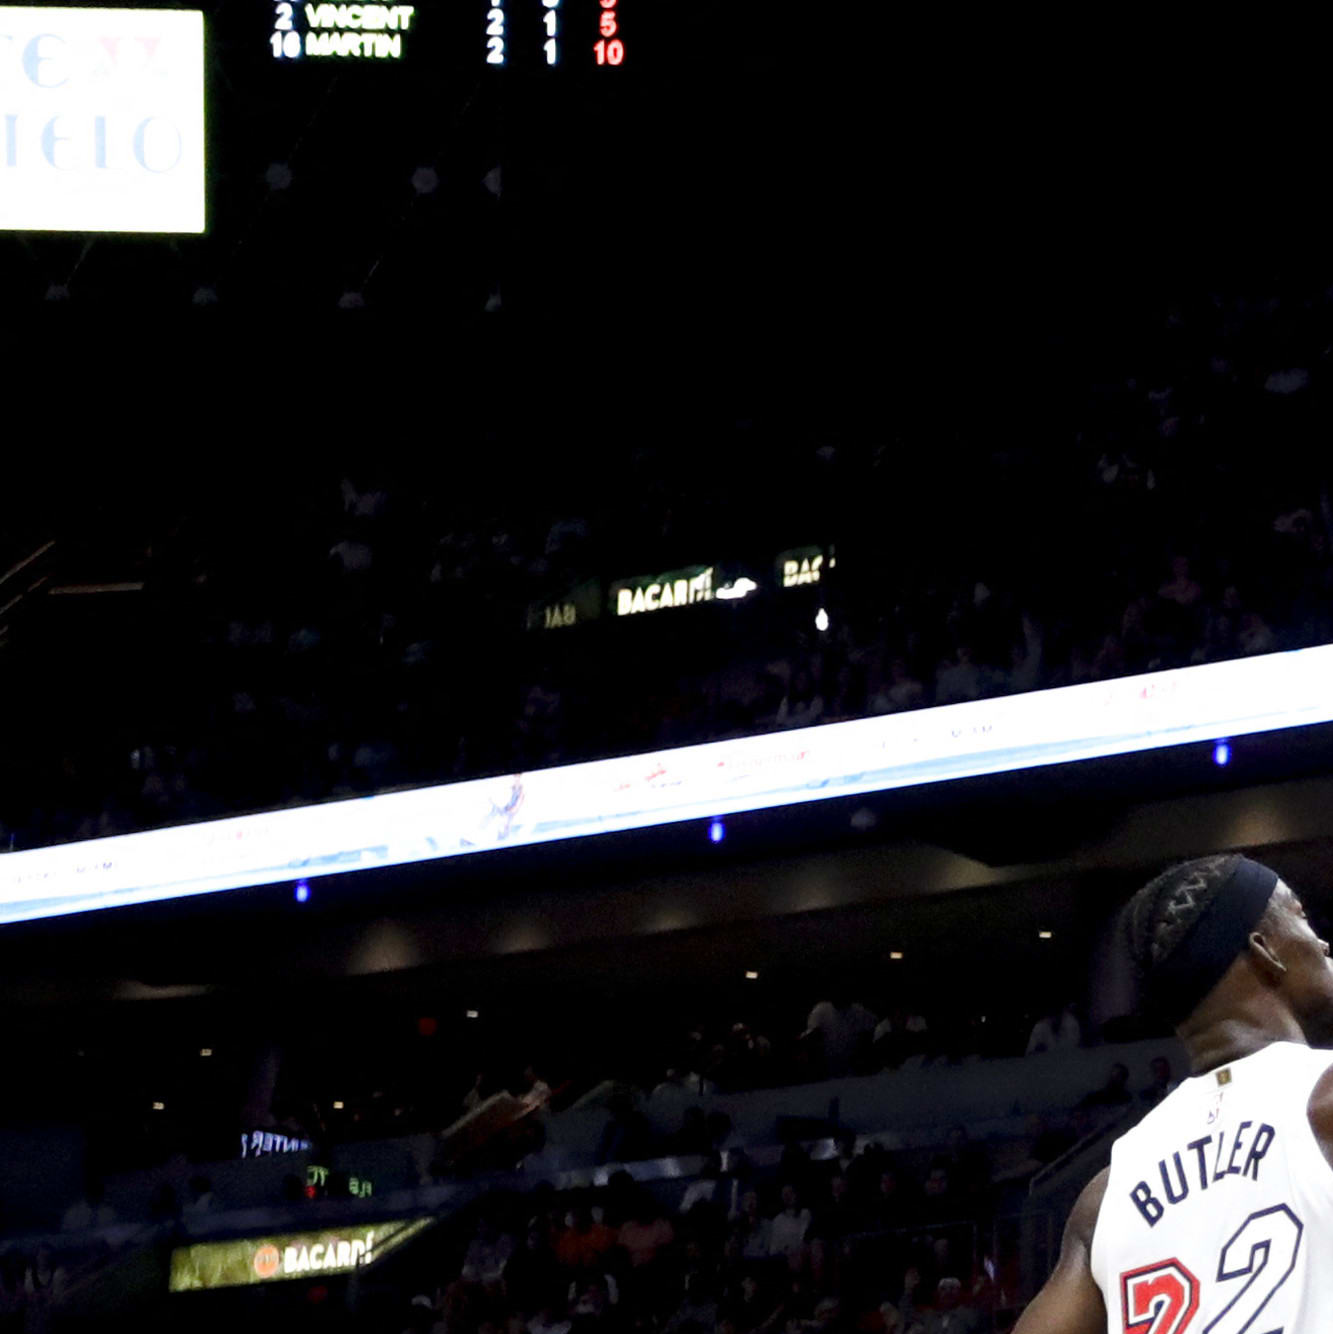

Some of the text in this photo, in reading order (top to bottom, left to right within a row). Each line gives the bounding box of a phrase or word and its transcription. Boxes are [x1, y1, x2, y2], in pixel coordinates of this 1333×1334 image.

[274, 4, 616, 36] 2 VINCENT 2 1 5
[305, 33, 402, 58] MARTIN
[486, 37, 504, 64] 2
[543, 38, 557, 65] 1
[593, 39, 624, 65] 10
[1130, 1121, 1275, 1227] BUTLER
